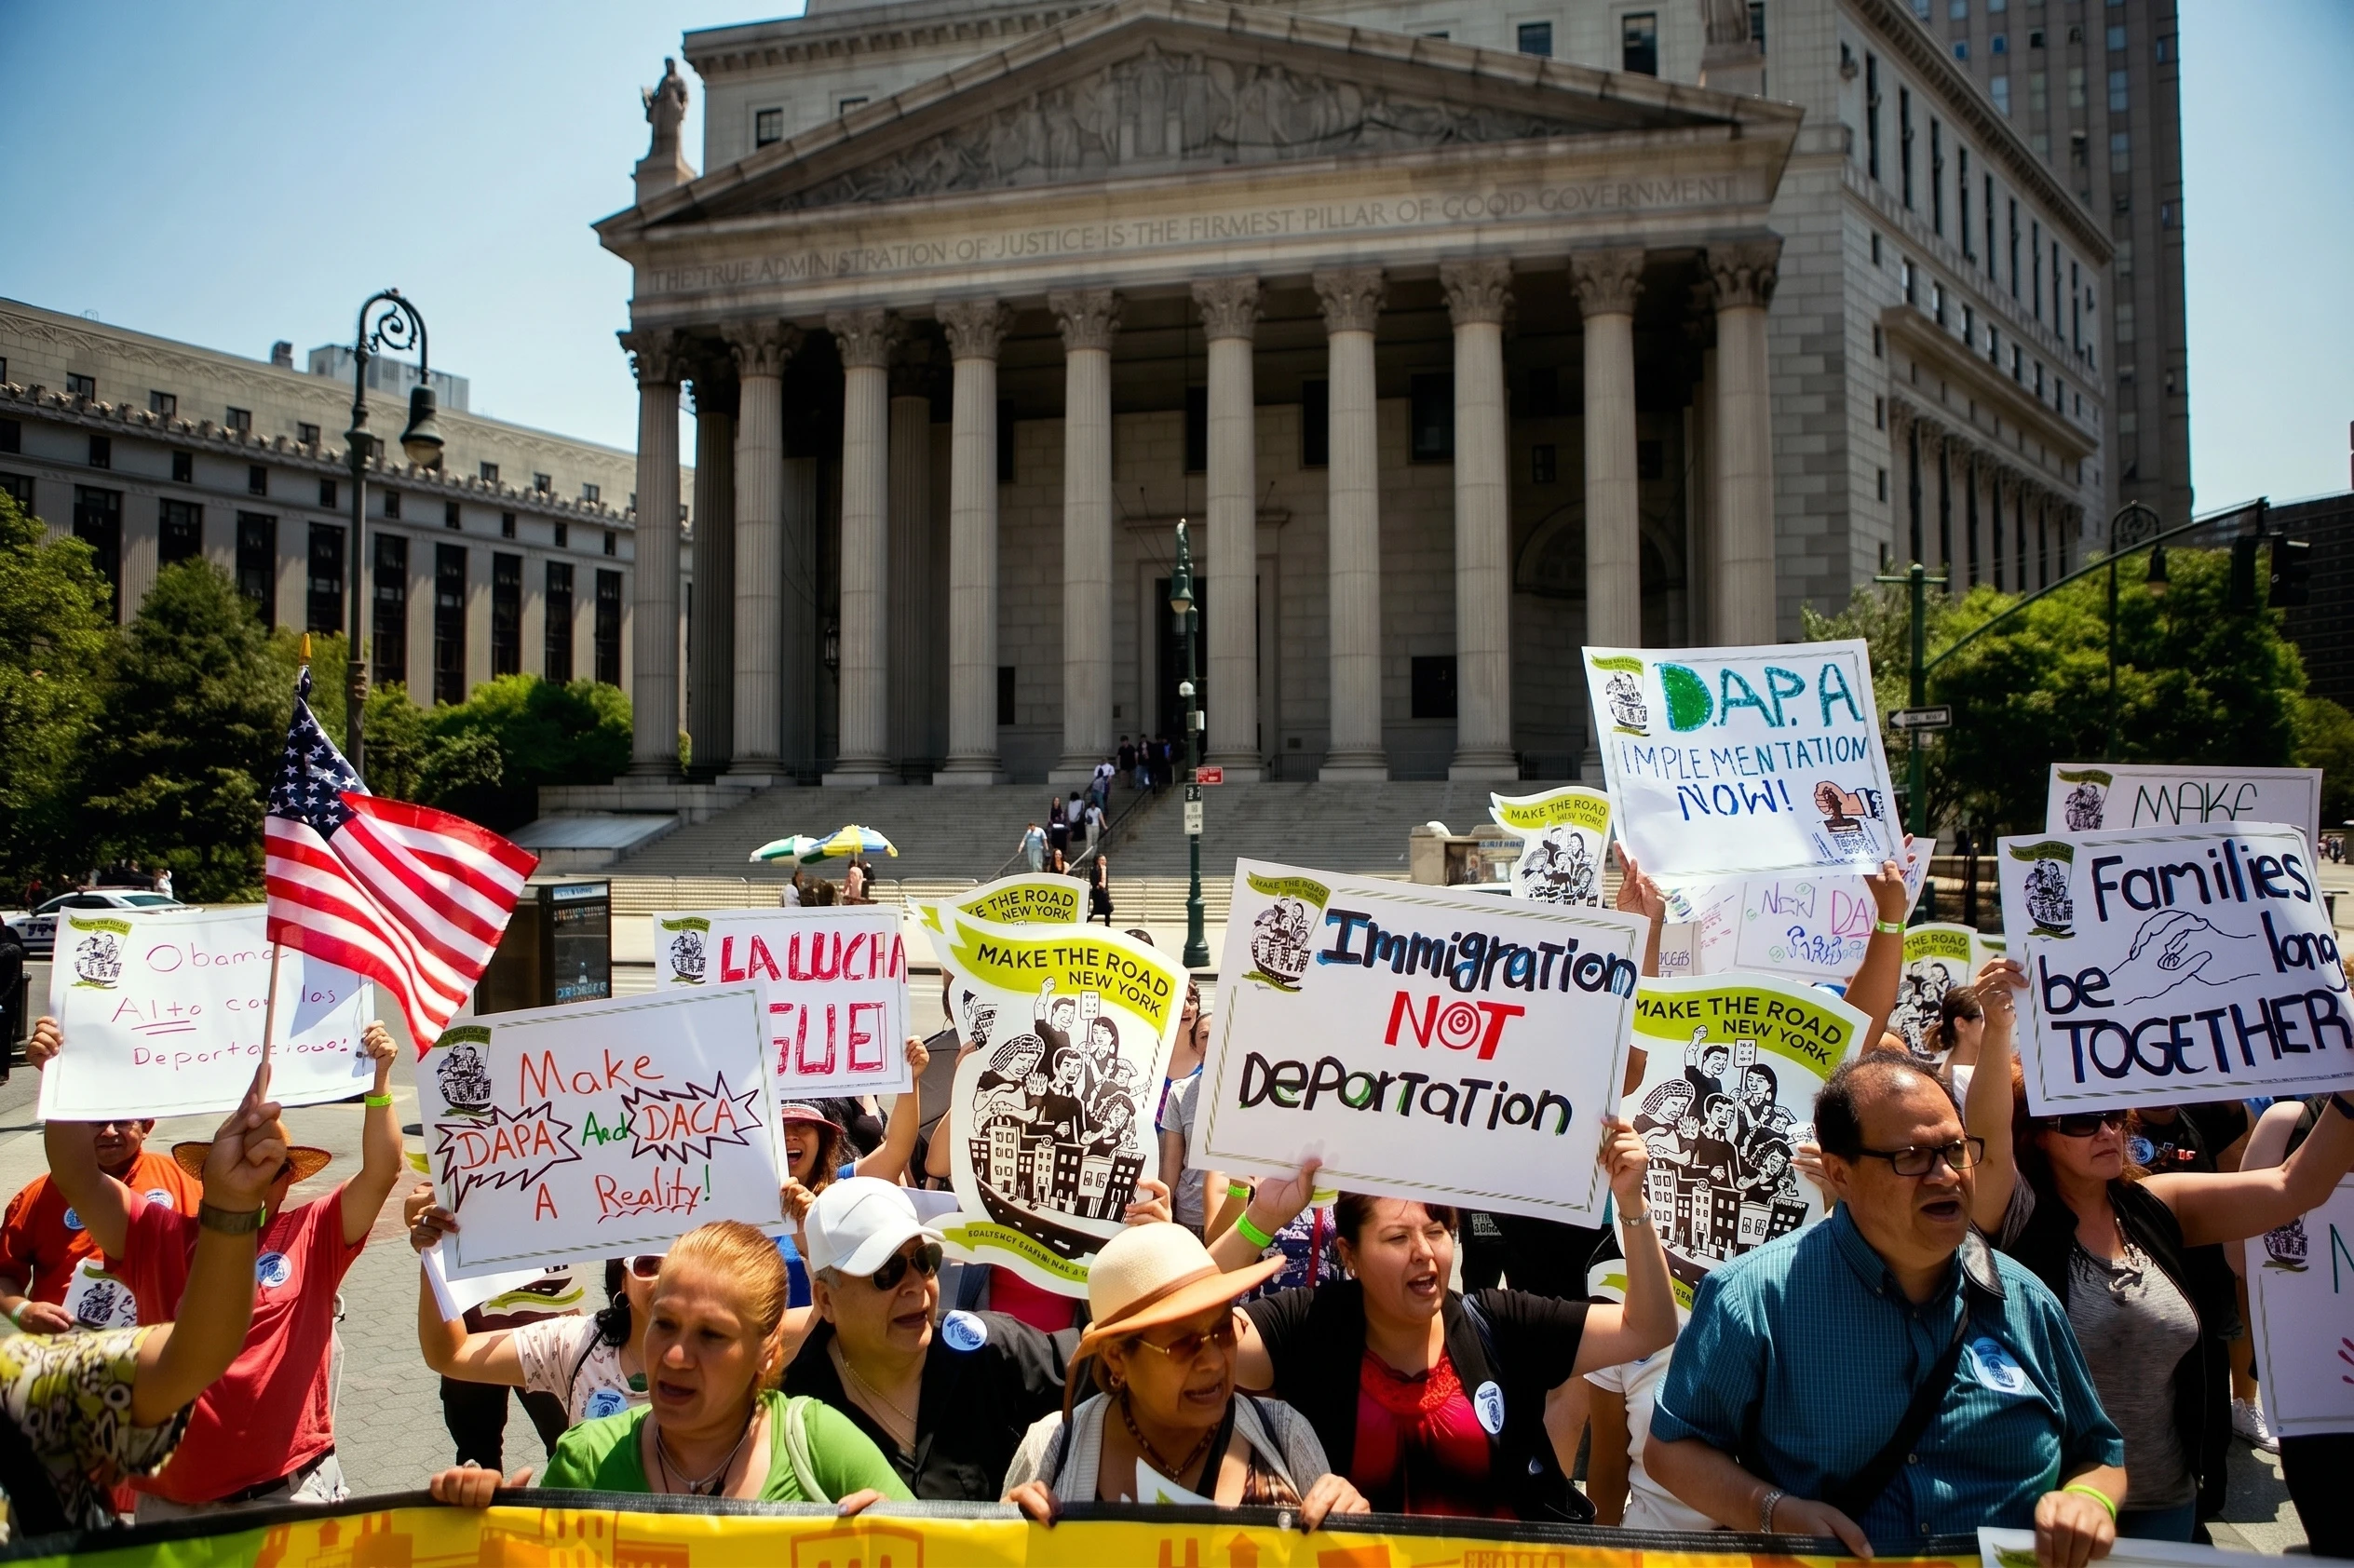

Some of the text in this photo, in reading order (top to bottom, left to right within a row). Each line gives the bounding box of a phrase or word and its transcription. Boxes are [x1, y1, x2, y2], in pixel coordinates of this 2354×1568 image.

[653, 175, 1738, 292] THE TRUE ADMINISTRATION OF JUSTICE IS THE FIRMEST PILLAR OF GOOD GOVERNMENT
[1621, 736, 1867, 780] IMPLEMENTATION
[1510, 799, 1607, 820] MAKE THE ROAD
[1677, 778, 1793, 820] NOW!
[988, 889, 1075, 911] THE ROAD
[2091, 839, 2311, 922] Families
[1001, 905, 1032, 922] NEW
[1035, 904, 1072, 922] YORK
[146, 942, 290, 973] Obama
[720, 934, 782, 983] LA
[1904, 934, 1968, 950] THE ROAD
[977, 943, 1169, 998] MAKE THE ROAD
[1069, 970, 1162, 1019] NEW YORK
[2038, 954, 2115, 1015] be
[112, 997, 202, 1023] Alto
[1384, 991, 1525, 1061] NOT
[1636, 996, 1842, 1046] MAKE THE ROAD
[1723, 1019, 1833, 1066] NEW YORK
[2050, 988, 2354, 1084] TOGETHER
[520, 1049, 664, 1107] Make
[456, 1119, 557, 1169] DAPA
[643, 1098, 737, 1142] DACA
[535, 1164, 710, 1222] A Reality!
